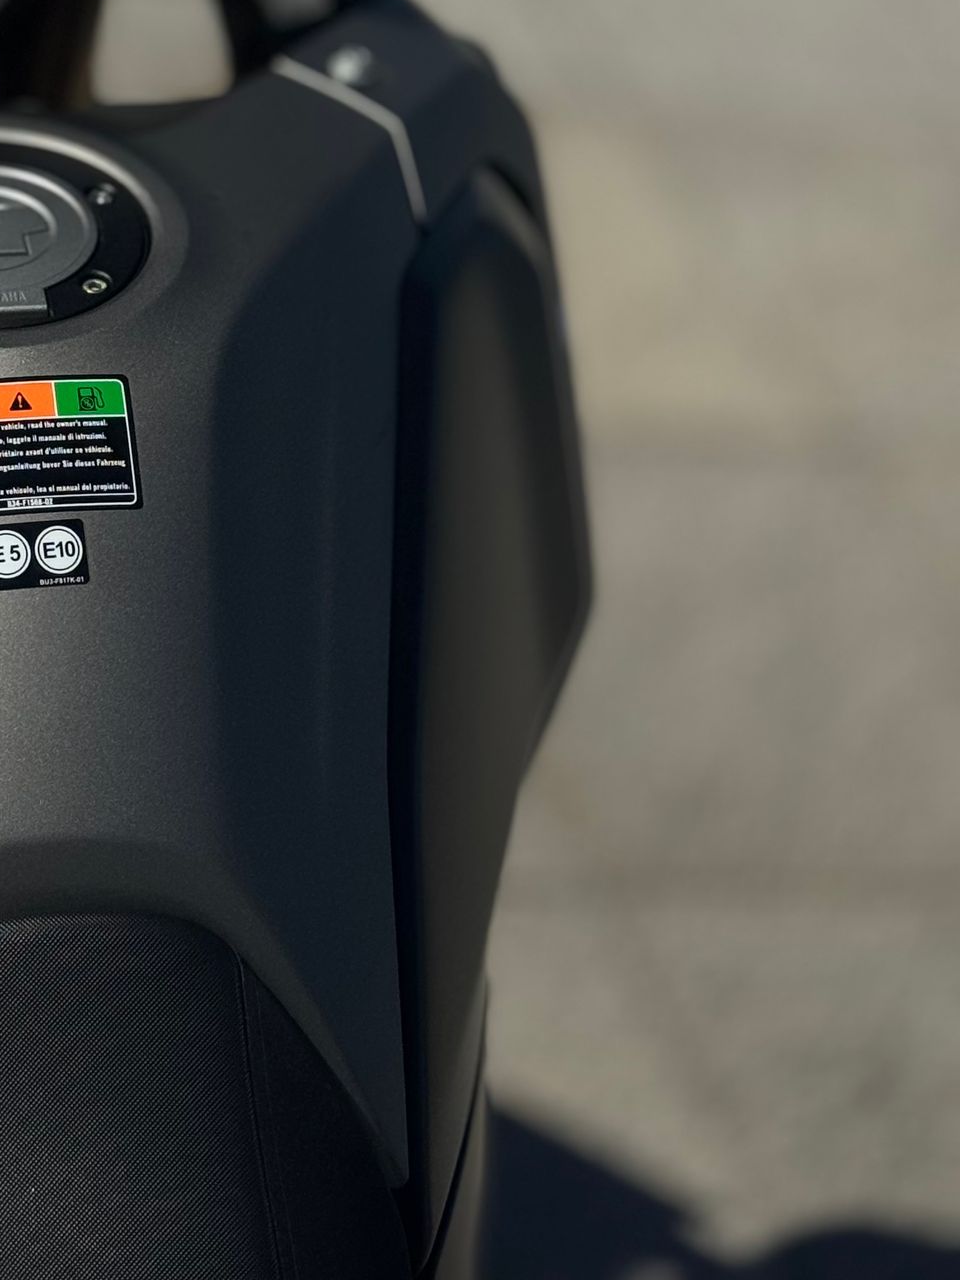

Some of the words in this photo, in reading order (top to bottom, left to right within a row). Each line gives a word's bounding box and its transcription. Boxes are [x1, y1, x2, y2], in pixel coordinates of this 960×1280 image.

[7, 436, 31, 444] leggete
[97, 459, 126, 467] Fahrzeug
[37, 485, 46, 493] lea
[43, 541, 76, 559] E10
